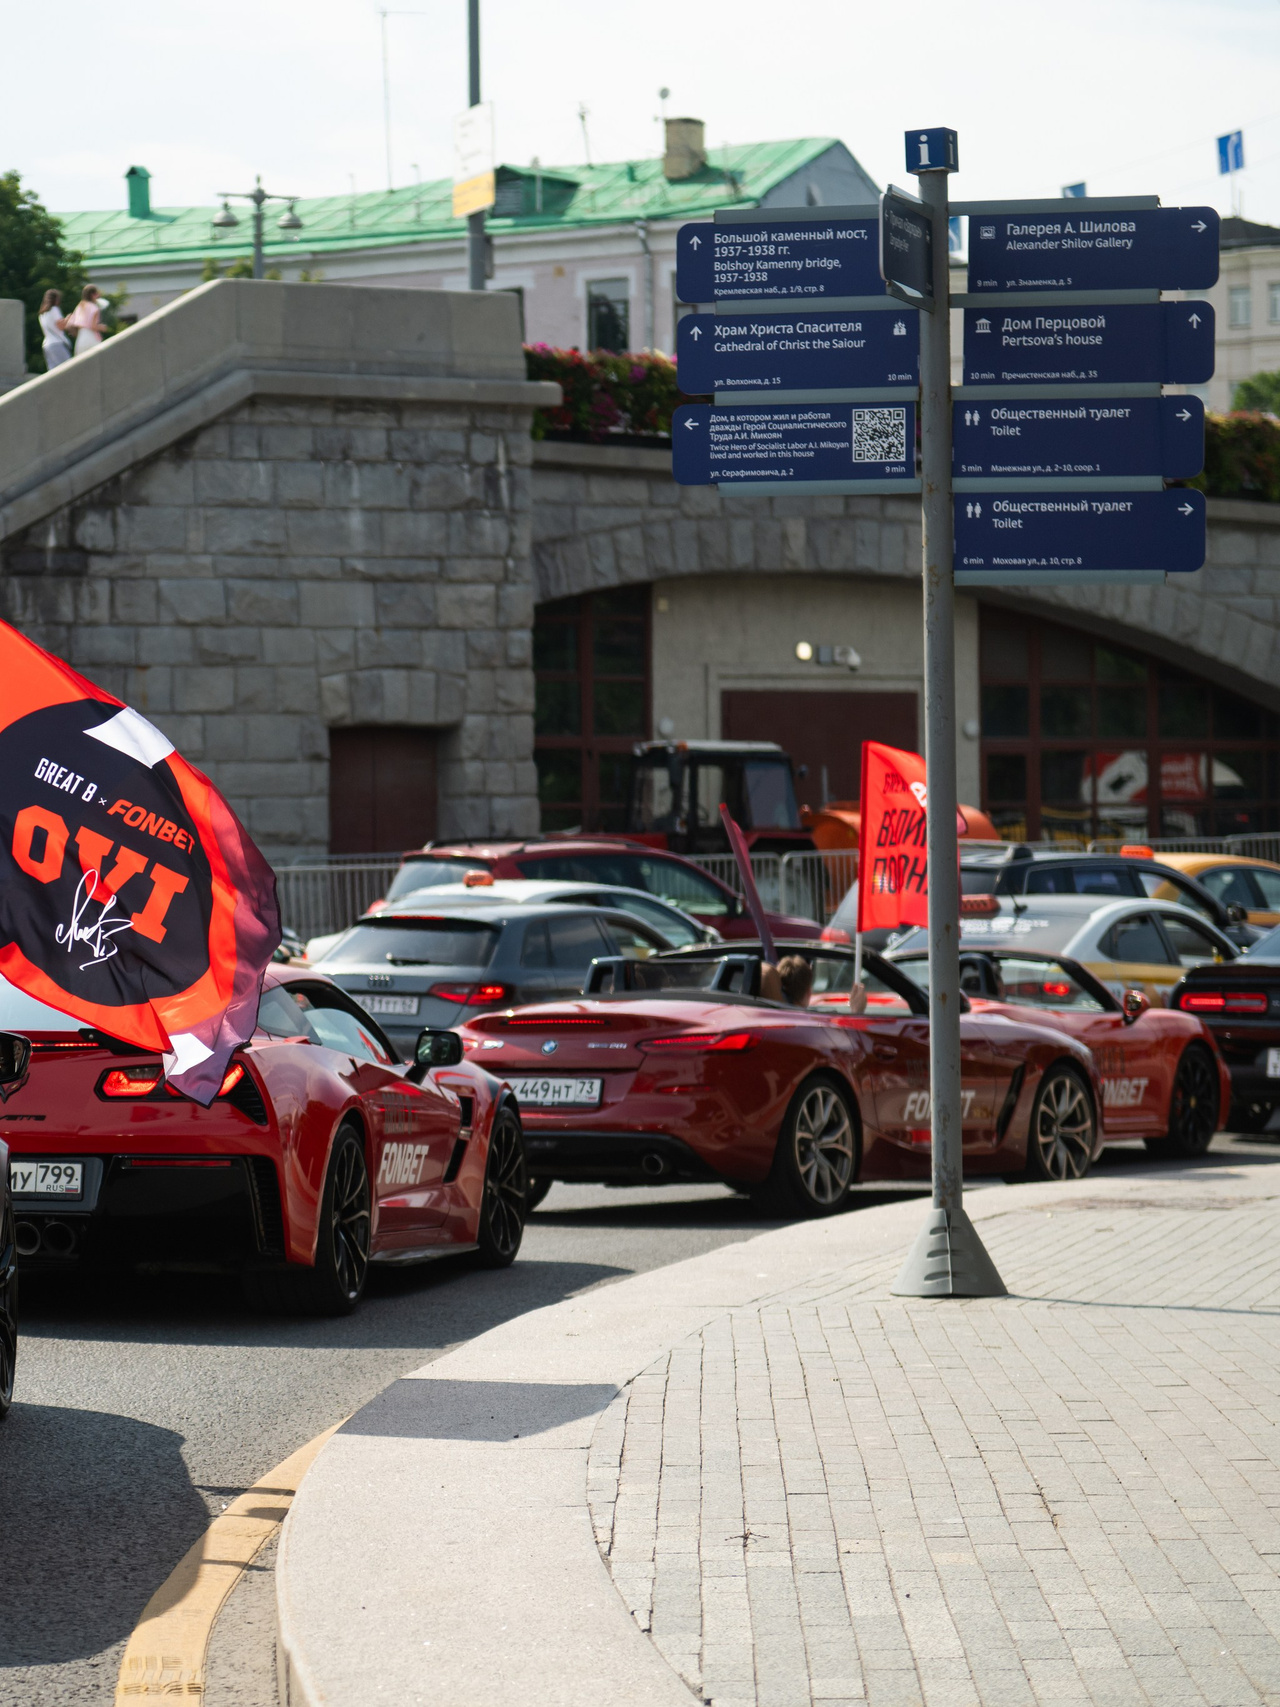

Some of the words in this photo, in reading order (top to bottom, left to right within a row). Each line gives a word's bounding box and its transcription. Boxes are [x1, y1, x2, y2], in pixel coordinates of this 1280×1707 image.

[1006, 223, 1061, 237] Галерея
[1064, 222, 1076, 234] А.
[1079, 220, 1136, 233] Шилова
[714, 231, 768, 244] Большой
[770, 229, 834, 243] каменный
[836, 229, 868, 240] мост,
[1006, 240, 1060, 250] Alexander
[1061, 239, 1094, 249] Shilov
[1095, 237, 1133, 250] Gallery
[714, 245, 775, 258] 1937-1938
[777, 246, 790, 255] гг.
[714, 260, 754, 272] Bolshoy
[756, 260, 803, 271] Kamenny
[805, 257, 842, 270] bridge,
[714, 272, 768, 283] 1937-1938
[976, 279, 982, 287] 9
[983, 279, 998, 287] min
[1006, 280, 1017, 288] ул.
[1018, 278, 1058, 287] Знаменка,
[1067, 277, 1072, 285] 5
[714, 288, 762, 297] Кремлевская
[804, 286, 818, 294] стр.
[1001, 318, 1032, 332] Дом
[1035, 315, 1106, 331] Перцовой
[714, 324, 748, 337] Храм
[750, 324, 794, 337] Христа
[796, 322, 862, 334] Спасителя
[714, 341, 765, 352] Cathedral
[766, 340, 778, 351] of
[779, 339, 812, 351] Christ
[812, 339, 831, 349] the
[832, 338, 866, 349] Saiour
[1065, 334, 1103, 345] house
[887, 373, 897, 381] 10
[897, 373, 912, 381] min
[970, 372, 981, 380] 10
[981, 372, 996, 380] min
[1001, 371, 1060, 380] Пречистенская
[1088, 370, 1098, 378] 35
[714, 379, 725, 388] ул.
[726, 378, 763, 386] Волхонка,
[771, 377, 781, 385] 15
[709, 414, 729, 423] Дом,
[736, 415, 771, 423] котором
[798, 411, 831, 421] работал
[991, 407, 1087, 420] Общественный
[1088, 407, 1132, 420] туалет
[709, 423, 741, 432] дважды
[742, 422, 767, 431] Герой
[767, 421, 847, 431] Социалистического
[990, 425, 1021, 436] Toilet
[709, 432, 733, 442] Труда
[733, 432, 749, 440] А.И.
[750, 431, 783, 440] Микоян
[730, 443, 747, 451] Hero
[756, 442, 787, 450] Socialist
[787, 442, 808, 450] Labor
[819, 442, 850, 451] Mikoyan
[710, 451, 727, 459] lived
[728, 451, 742, 459] and
[742, 451, 769, 459] worked
[769, 450, 777, 458] in
[777, 450, 792, 458] this
[792, 450, 815, 458] house
[710, 471, 721, 479] ул.
[721, 468, 780, 478] Серафимовича,
[885, 466, 891, 474] 9
[891, 465, 906, 473] min
[961, 464, 967, 472] 5
[967, 464, 983, 472] min
[991, 464, 1032, 472] Манежная
[1074, 464, 1095, 473] соор.
[992, 500, 1089, 514] Общественный
[1091, 501, 1133, 514] туалет
[992, 518, 1023, 529] Toilet
[963, 557, 969, 565] 6
[969, 557, 984, 565] min
[992, 557, 1027, 565] Моховая
[1061, 557, 1075, 566] стр.
[34, 757, 84, 796] GREAT
[81, 782, 98, 803] 8
[107, 798, 196, 855] FONBET
[11, 804, 190, 944] OVI
[579, 1081, 595, 1096] 73
[377, 1142, 430, 1185] FONBET
[39, 1165, 76, 1184] 799
[46, 1184, 64, 1192] RUS
